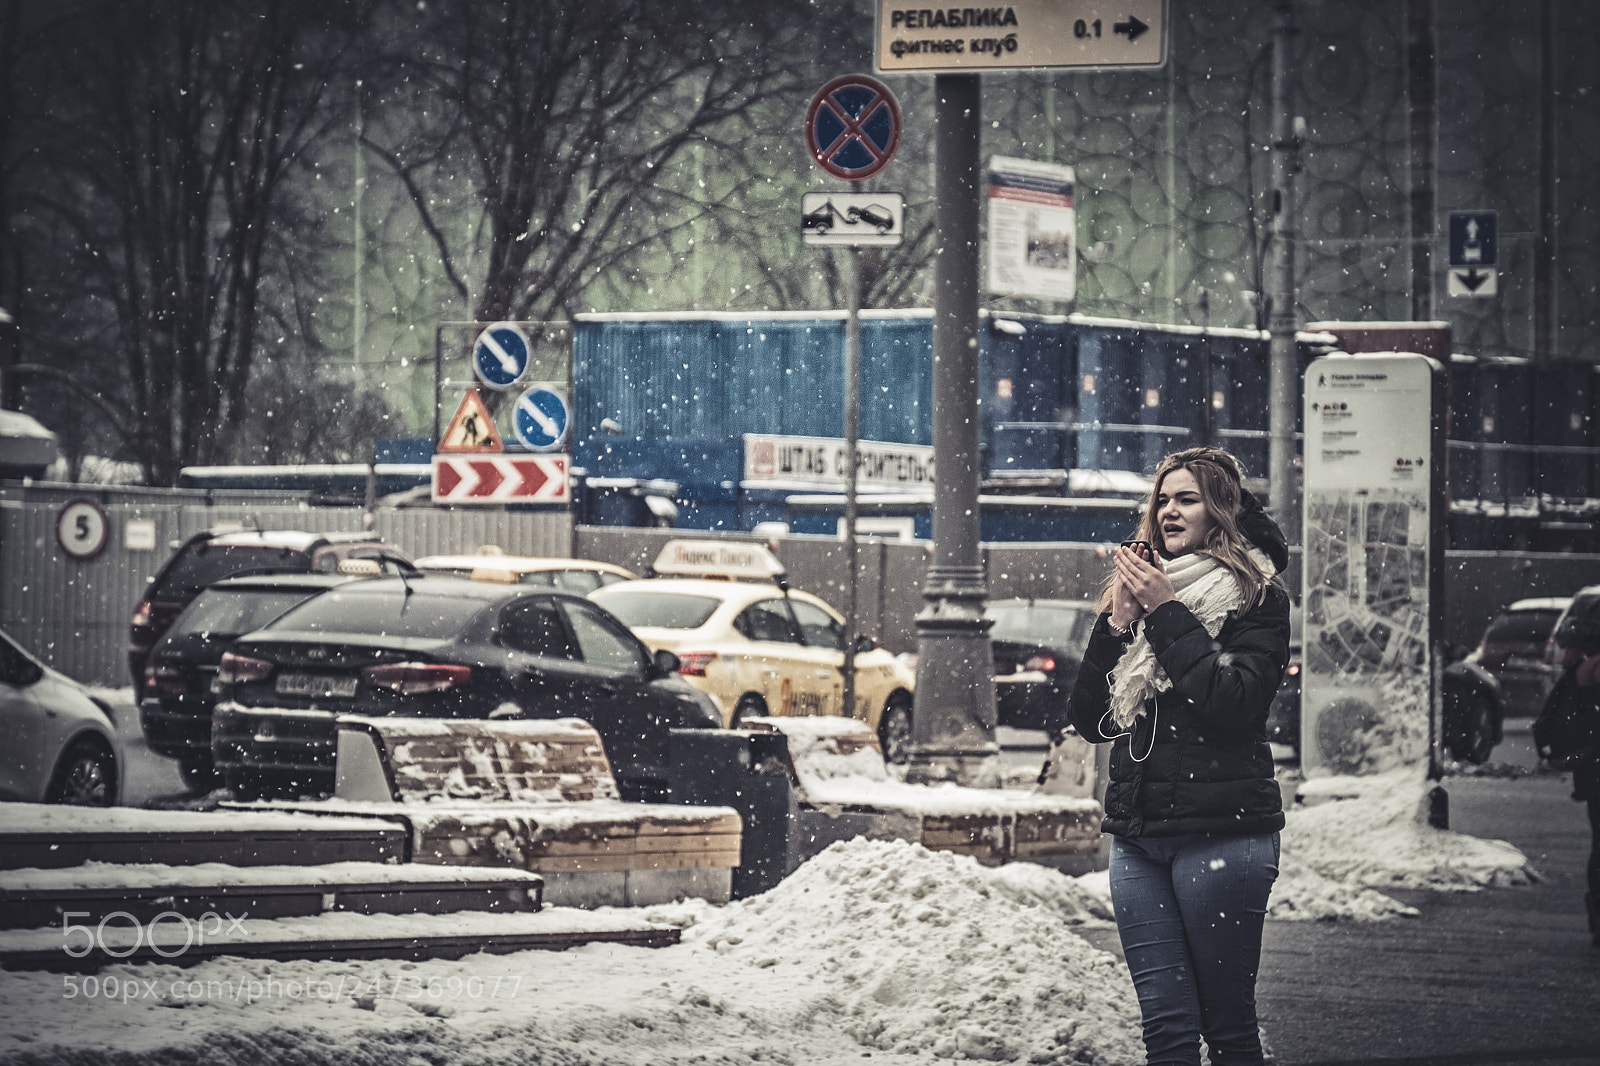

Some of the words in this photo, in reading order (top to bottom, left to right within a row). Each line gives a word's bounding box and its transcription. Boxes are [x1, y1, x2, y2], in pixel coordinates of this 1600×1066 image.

[890, 7, 1018, 29] РЕПАБЛИКА
[1072, 18, 1103, 39] 0.1
[890, 37, 965, 58] фитнес
[969, 33, 1018, 57] клуб
[778, 445, 827, 475] ШТАБ
[74, 514, 90, 541] 5
